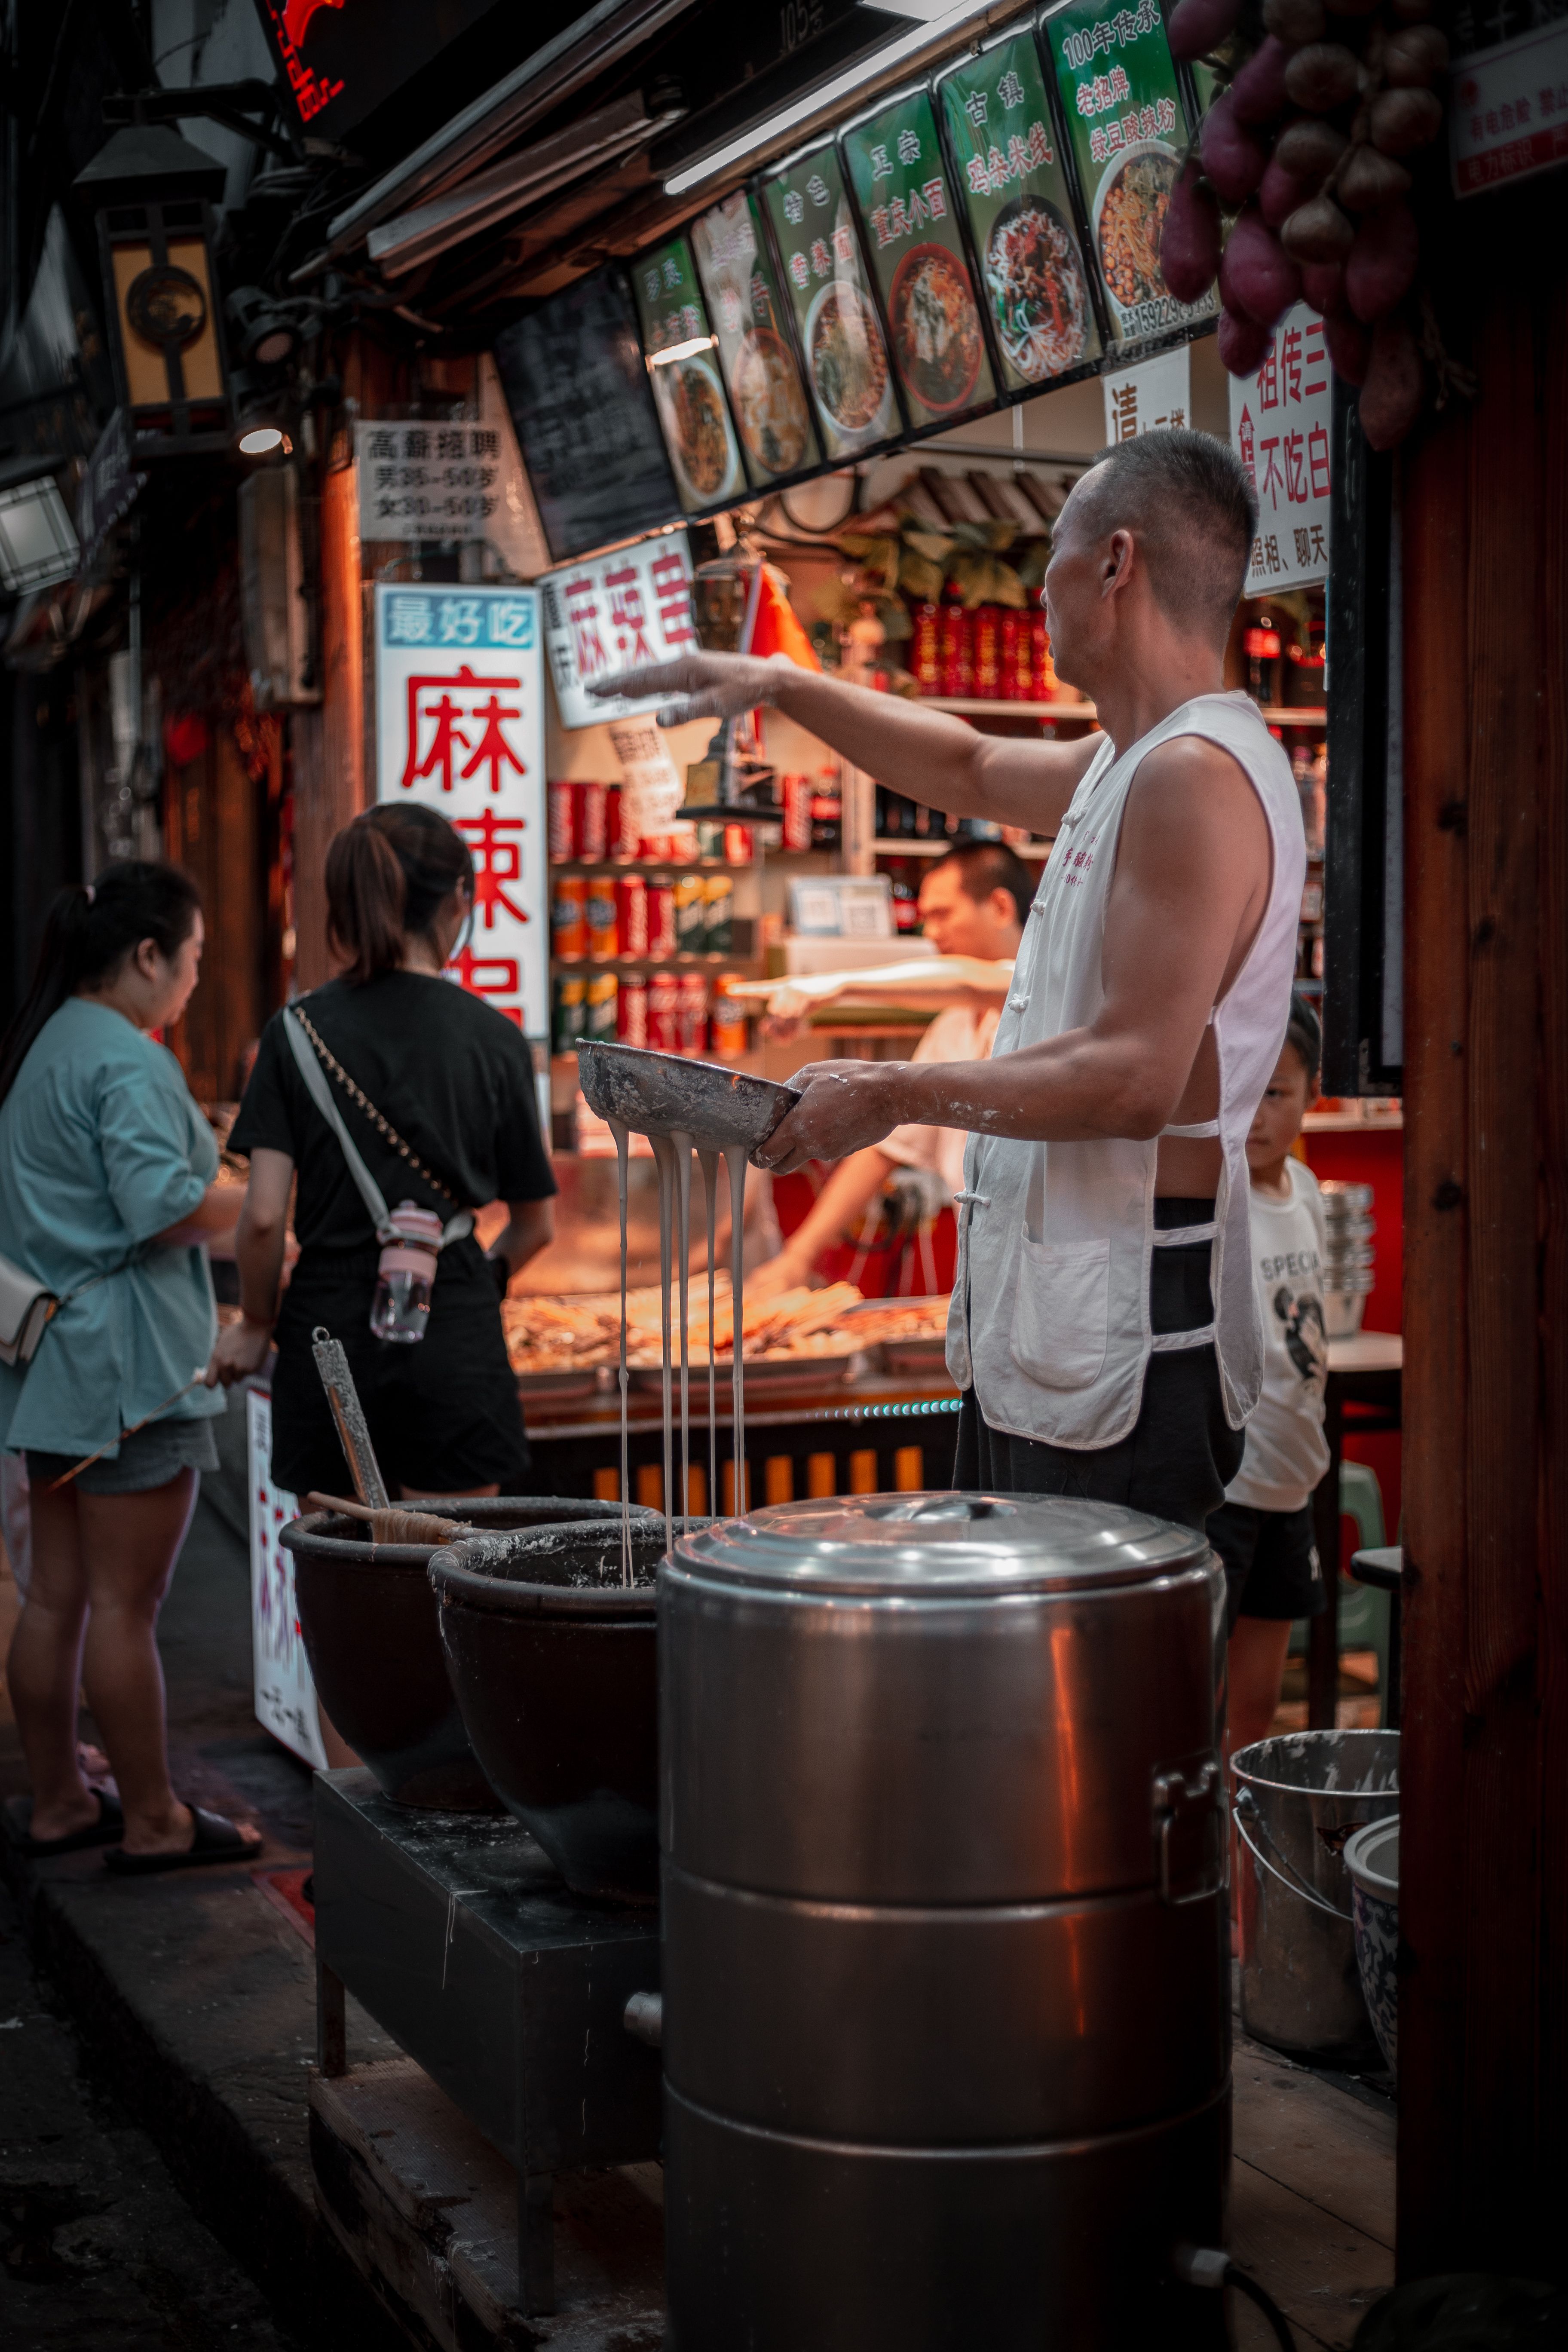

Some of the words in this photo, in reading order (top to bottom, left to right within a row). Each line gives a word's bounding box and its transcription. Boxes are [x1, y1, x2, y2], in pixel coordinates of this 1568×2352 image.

[1062, 0, 1161, 70] 100年传承
[965, 71, 1024, 127] 古镇
[1076, 64, 1130, 117] 老招牌
[870, 129, 921, 181] 正宗
[1090, 97, 1176, 162] 绿豆酸辣粉
[783, 175, 830, 225] 特色
[870, 177, 947, 250] 重庆小面
[1257, 322, 1326, 413] 祖传三
[369, 430, 499, 459] 高薪招聘
[1260, 421, 1331, 511] 不吃白
[390, 597, 533, 646] 最好吃
[566, 544, 694, 676] 麻辣串
